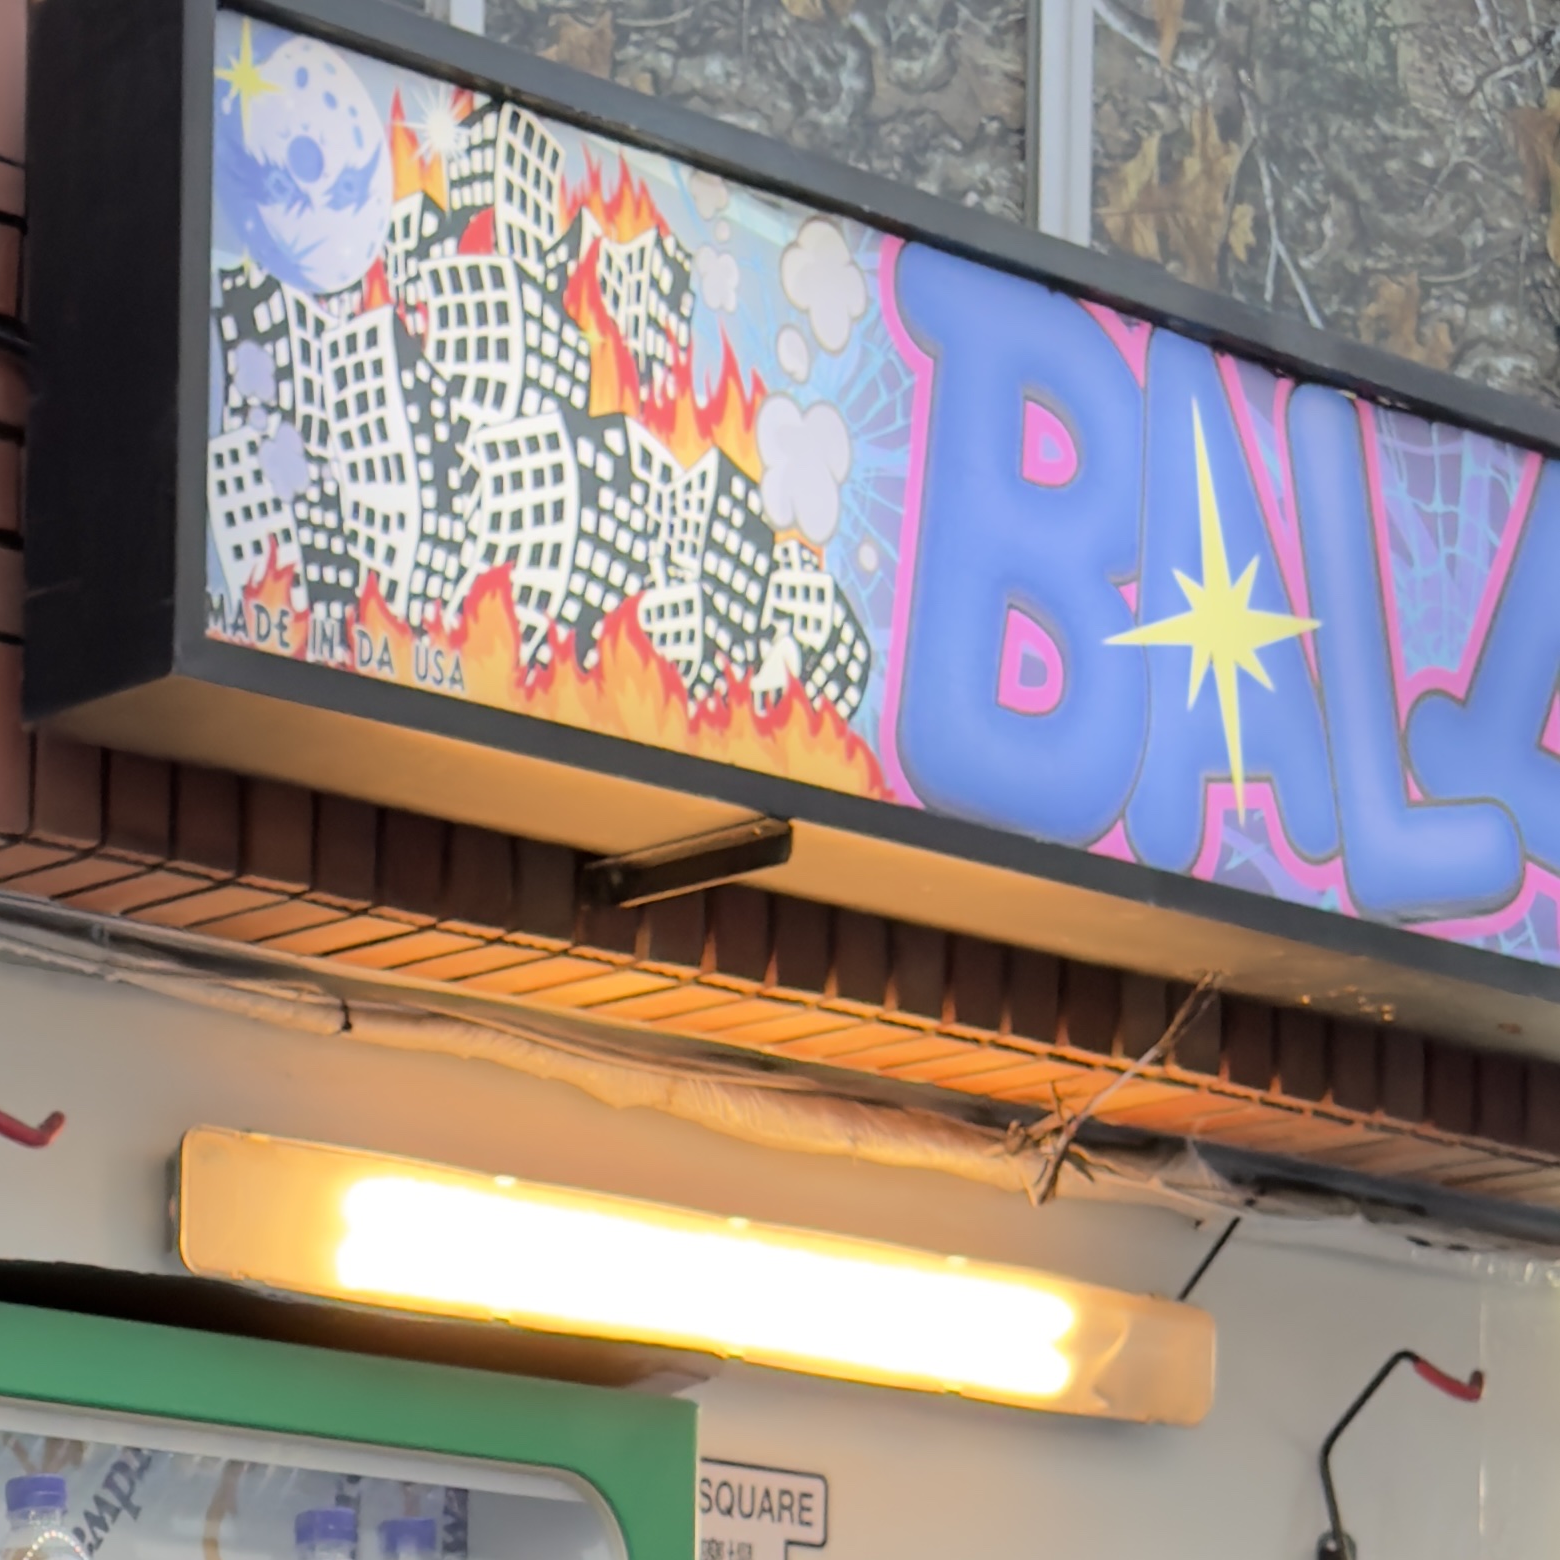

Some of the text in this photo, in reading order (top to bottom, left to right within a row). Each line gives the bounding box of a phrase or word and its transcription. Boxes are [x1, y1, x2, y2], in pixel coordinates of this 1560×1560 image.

[207, 603, 466, 691] MADE IN DA USA
[699, 1476, 814, 1527] SQUARE
